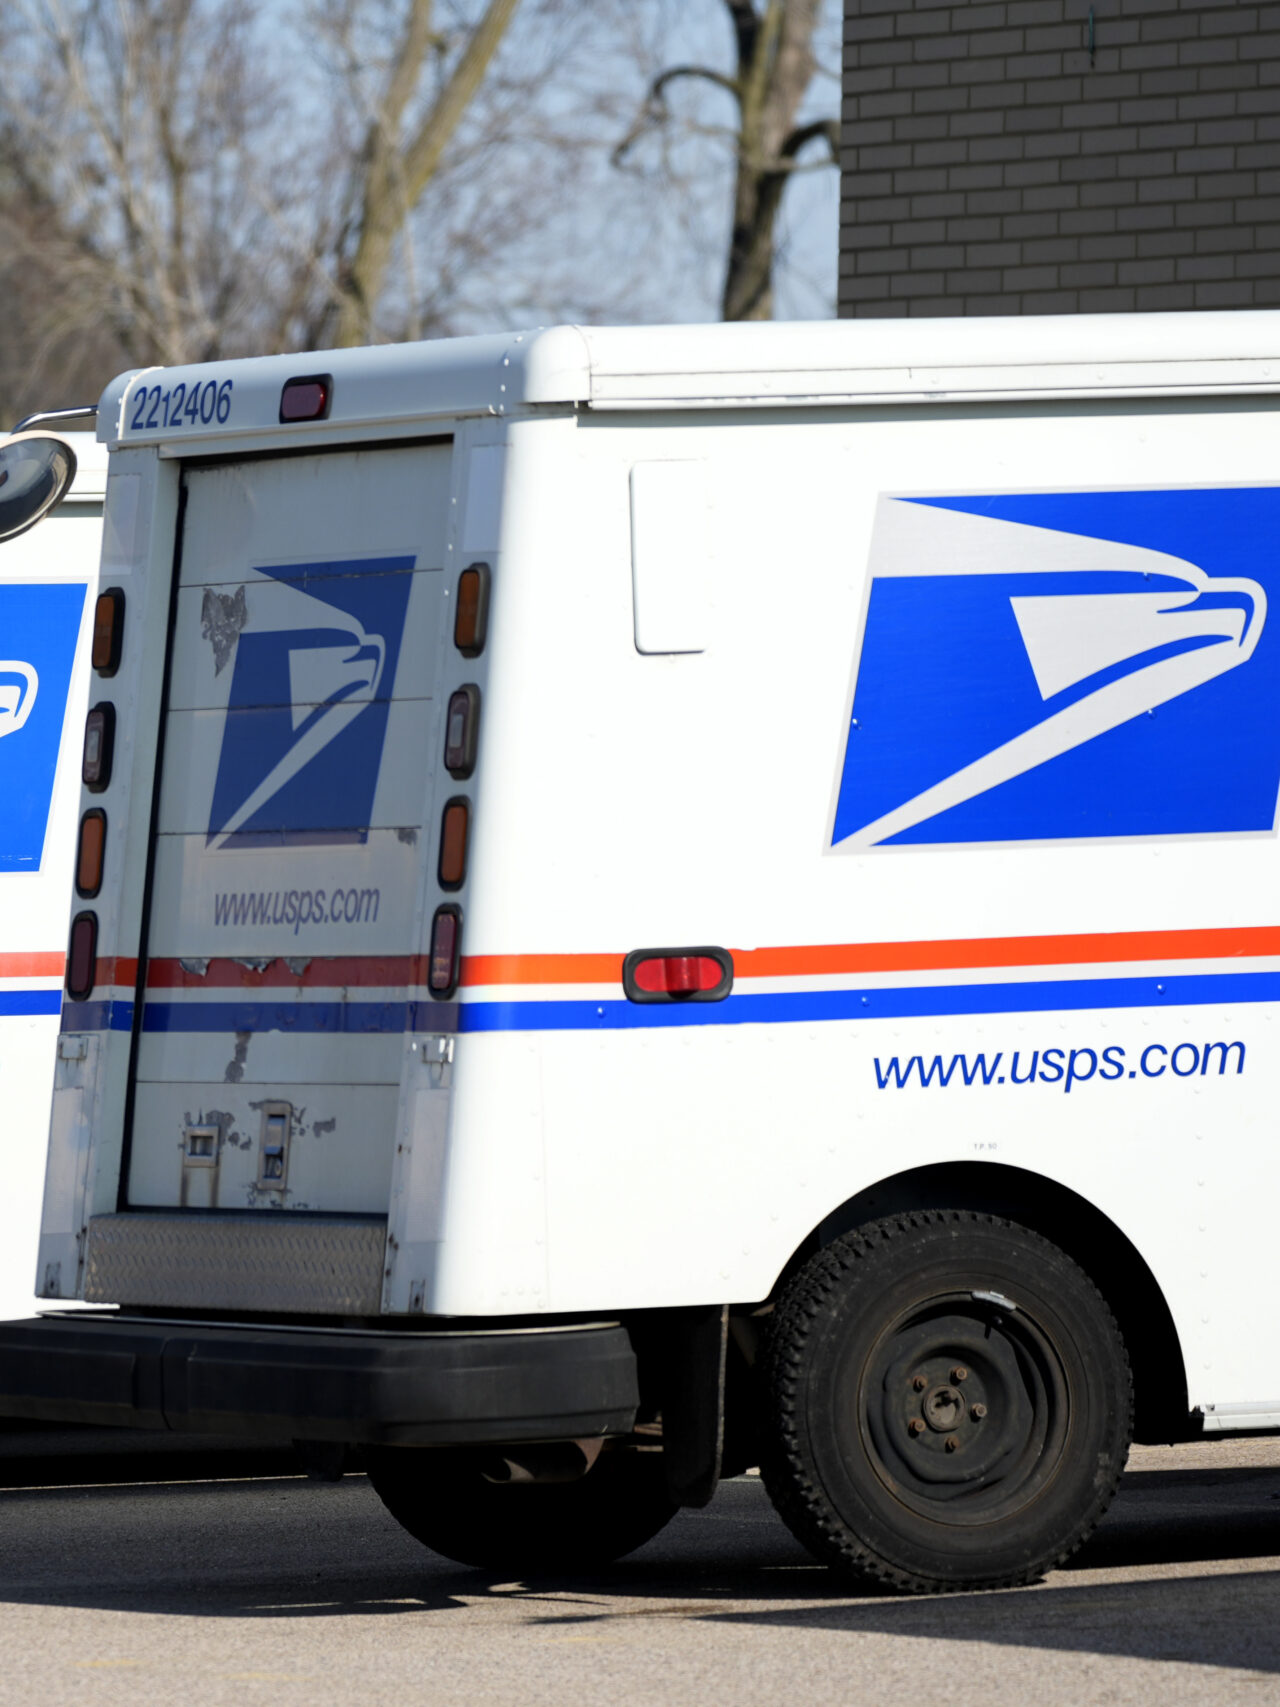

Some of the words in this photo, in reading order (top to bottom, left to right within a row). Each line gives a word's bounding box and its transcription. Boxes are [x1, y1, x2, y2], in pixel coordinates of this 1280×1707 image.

[130, 379, 233, 430] 2212406
[215, 887, 380, 936] www.usps.com
[873, 1041, 1246, 1093] www.usps.com
